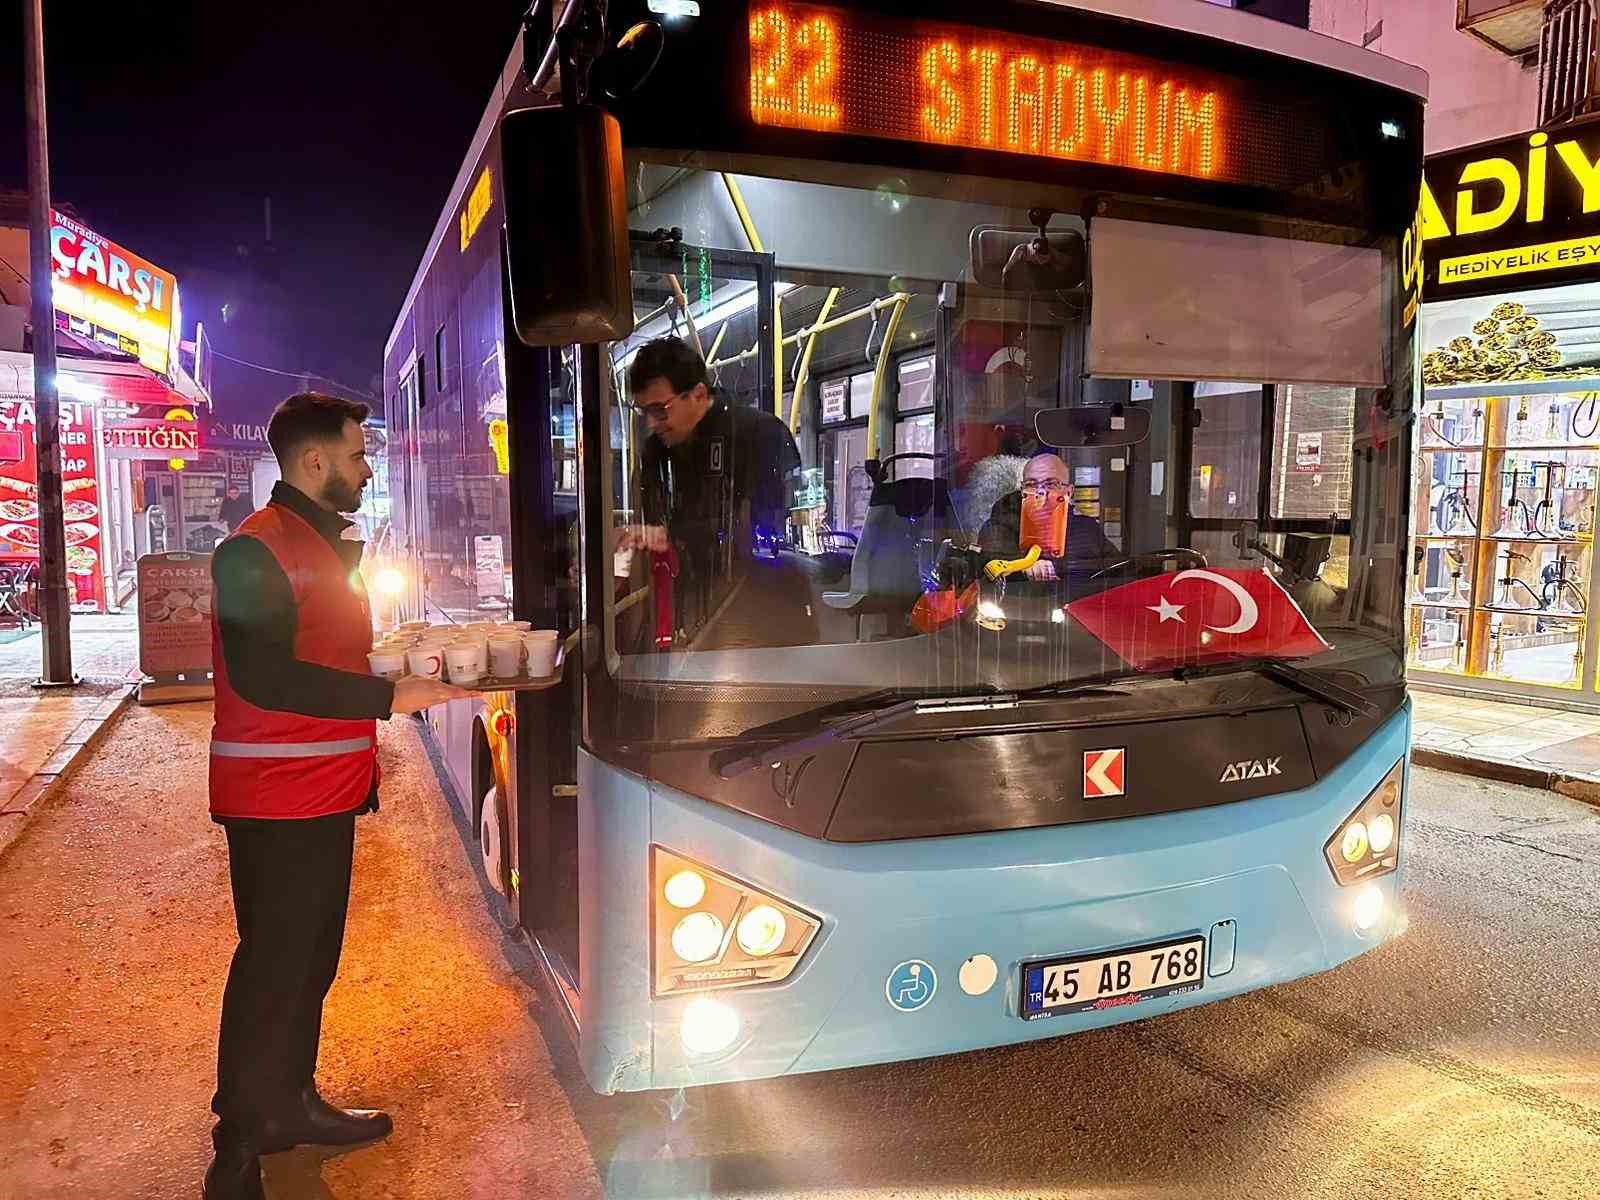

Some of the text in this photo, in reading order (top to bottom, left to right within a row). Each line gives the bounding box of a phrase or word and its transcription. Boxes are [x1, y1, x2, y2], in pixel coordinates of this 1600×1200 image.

[750, 9, 1218, 176] 22 STADYUM
[55, 211, 109, 249] Muradiye
[50, 226, 163, 313] ÇARŞI
[1446, 251, 1549, 277] HEDİYELİK
[0, 402, 83, 431] ÇAŞI
[1219, 755, 1282, 783] ATAK
[1044, 969, 1080, 1003] 45
[1098, 960, 1131, 994] AB
[1150, 948, 1198, 984] 768
[1029, 992, 1043, 1002] TR
